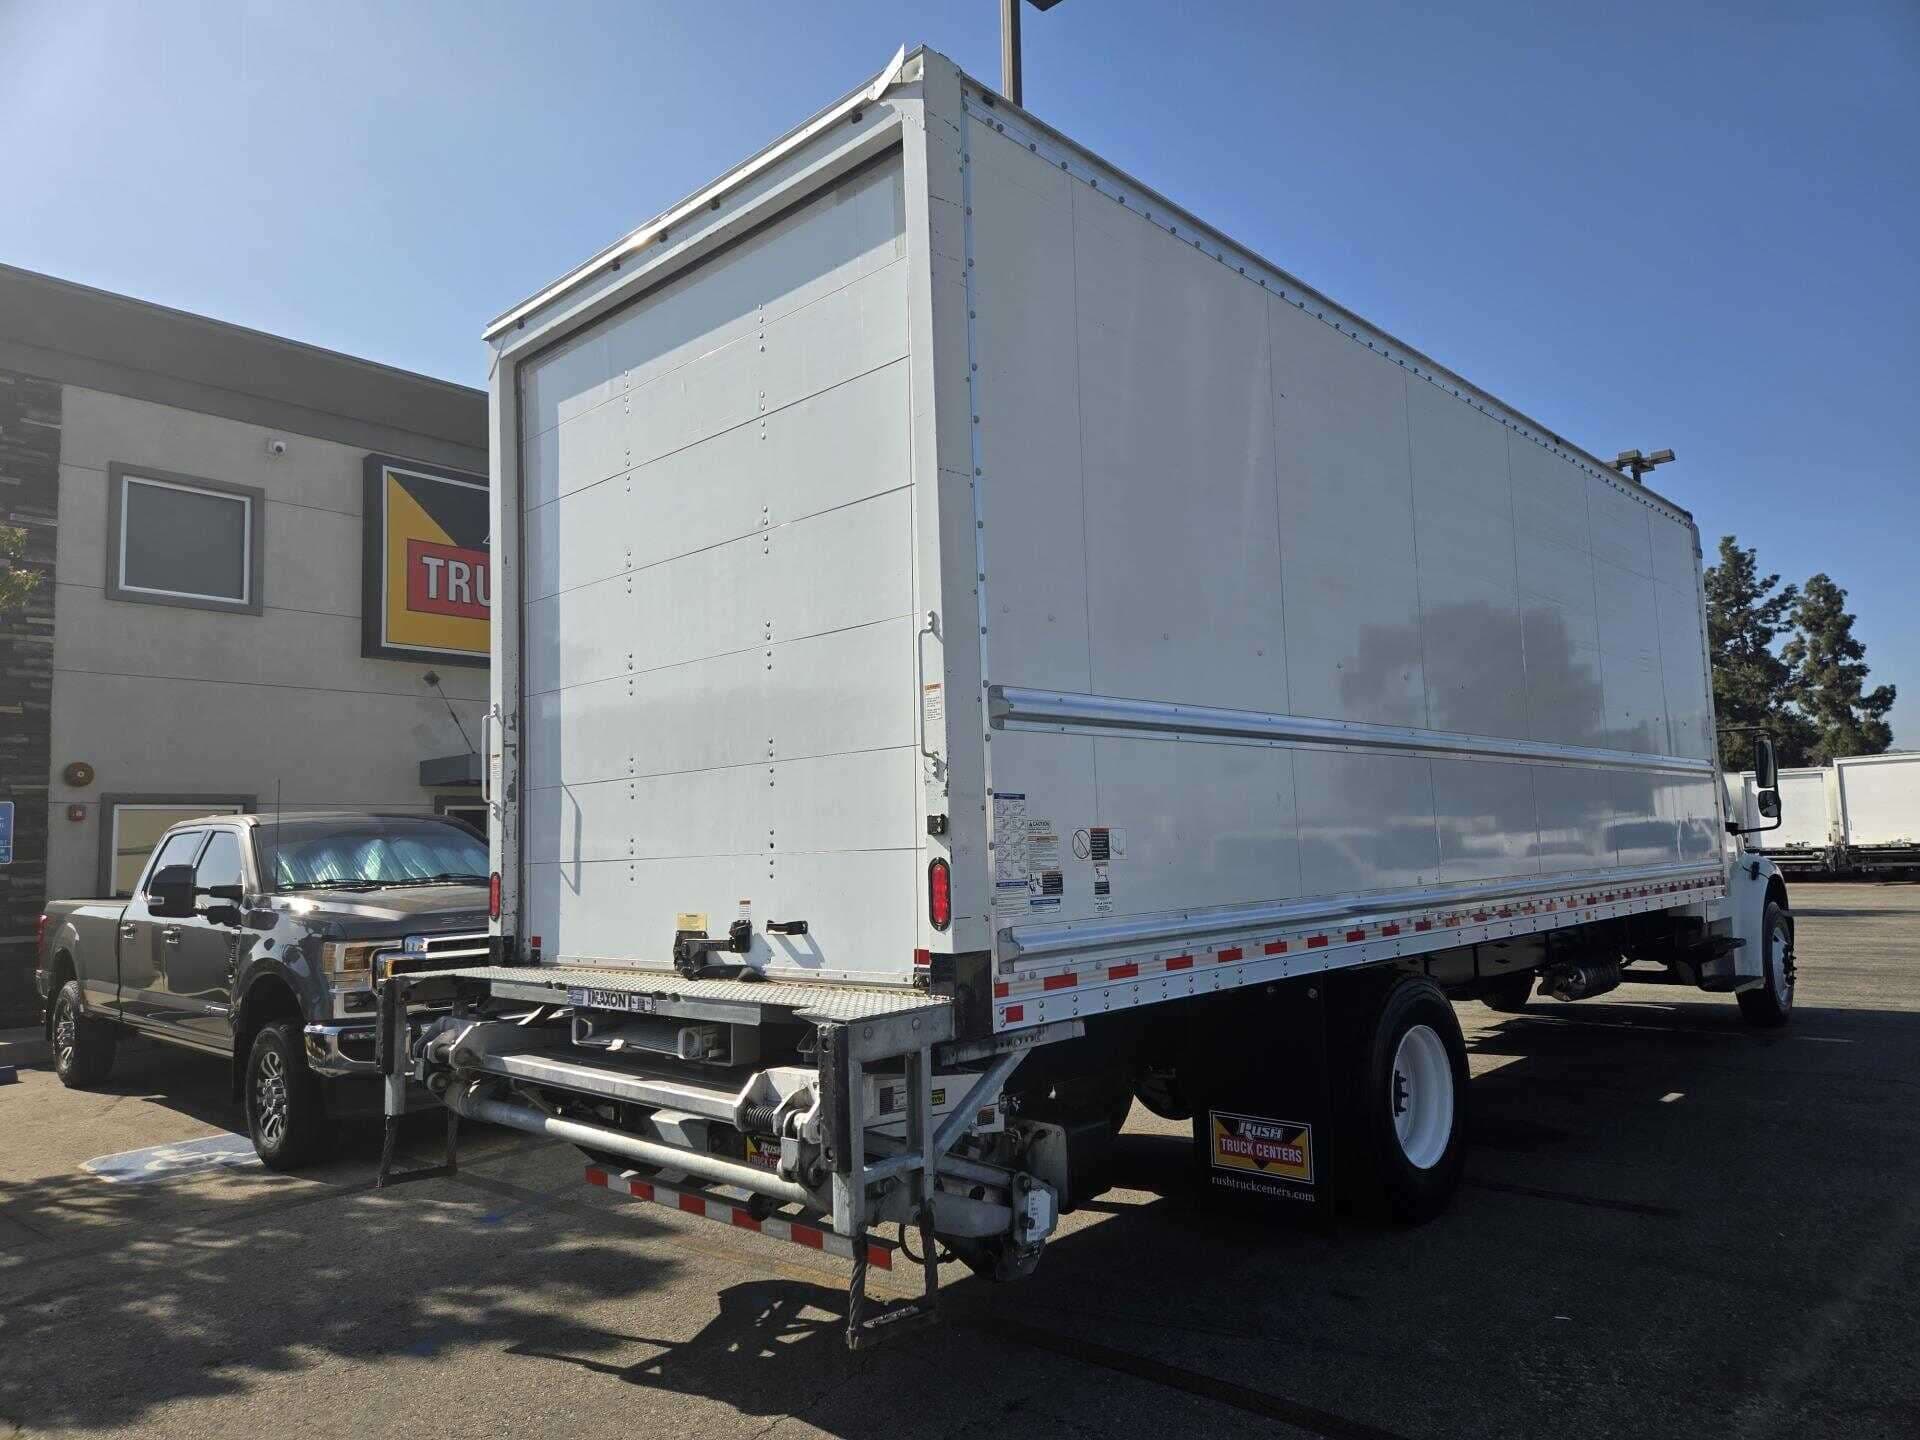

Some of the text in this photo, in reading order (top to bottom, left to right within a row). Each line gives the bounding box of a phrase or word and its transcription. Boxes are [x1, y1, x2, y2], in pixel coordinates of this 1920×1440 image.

[1238, 1120, 1284, 1140] RUSH
[1221, 1138, 1302, 1163] TRUCK CENTERS
[1210, 1176, 1315, 1202] rushtruckcenters.com
